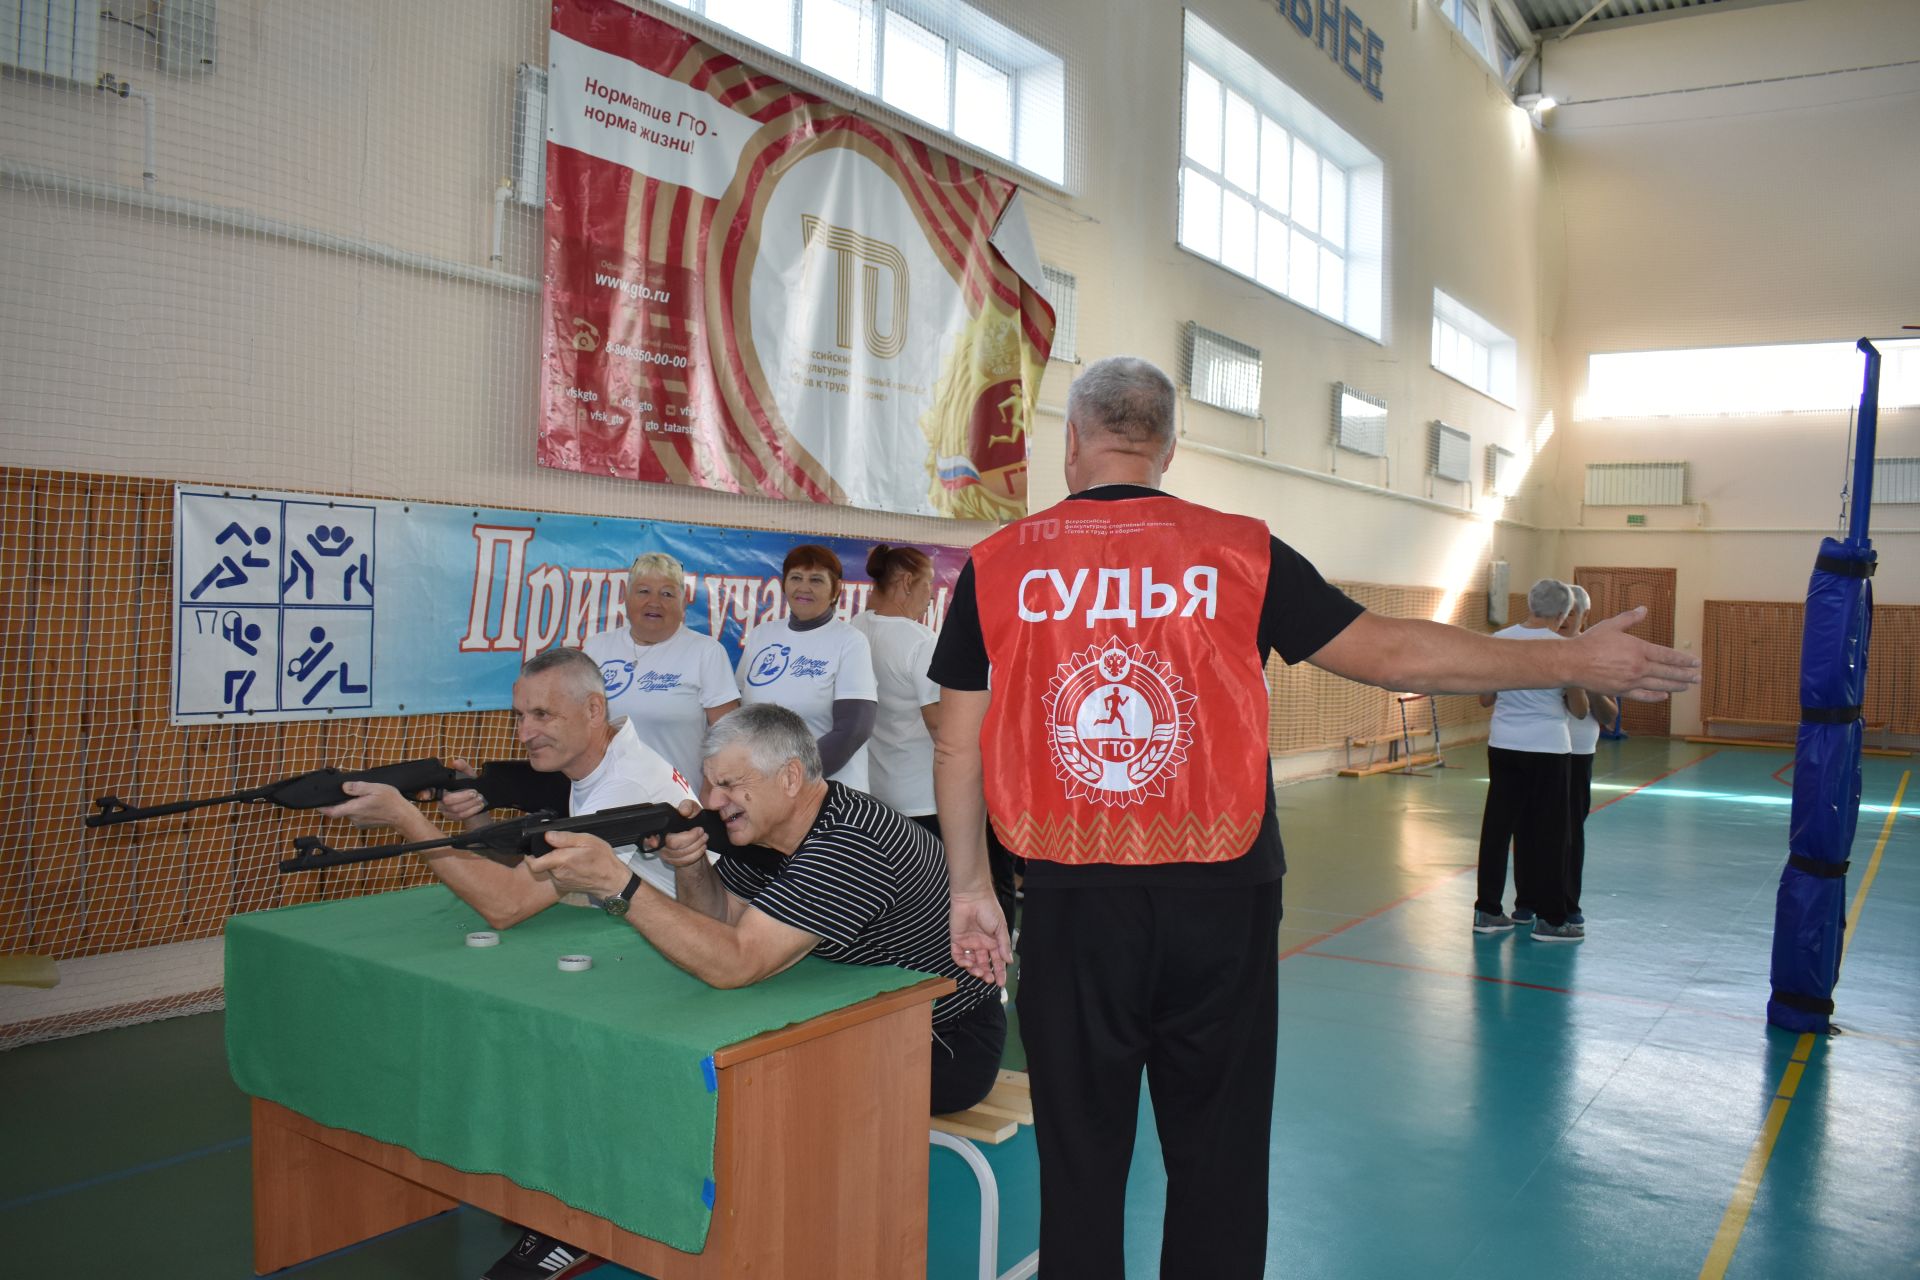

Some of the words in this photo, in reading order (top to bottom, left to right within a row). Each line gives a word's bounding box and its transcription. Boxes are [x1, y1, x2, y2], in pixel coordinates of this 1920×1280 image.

[1277, 0, 1384, 103] ЬНЕЕ
[585, 76, 671, 124] Норматив
[677, 111, 707, 136] ГТО
[584, 105, 637, 133] норма
[640, 123, 694, 155] жизни!
[595, 273, 670, 303] www.gto.ru
[590, 410, 624, 425] vfsk_gto
[1018, 518, 1061, 545] ГТО
[1018, 566, 1218, 629] СУДЬЯ
[1098, 740, 1135, 757] ГТО
